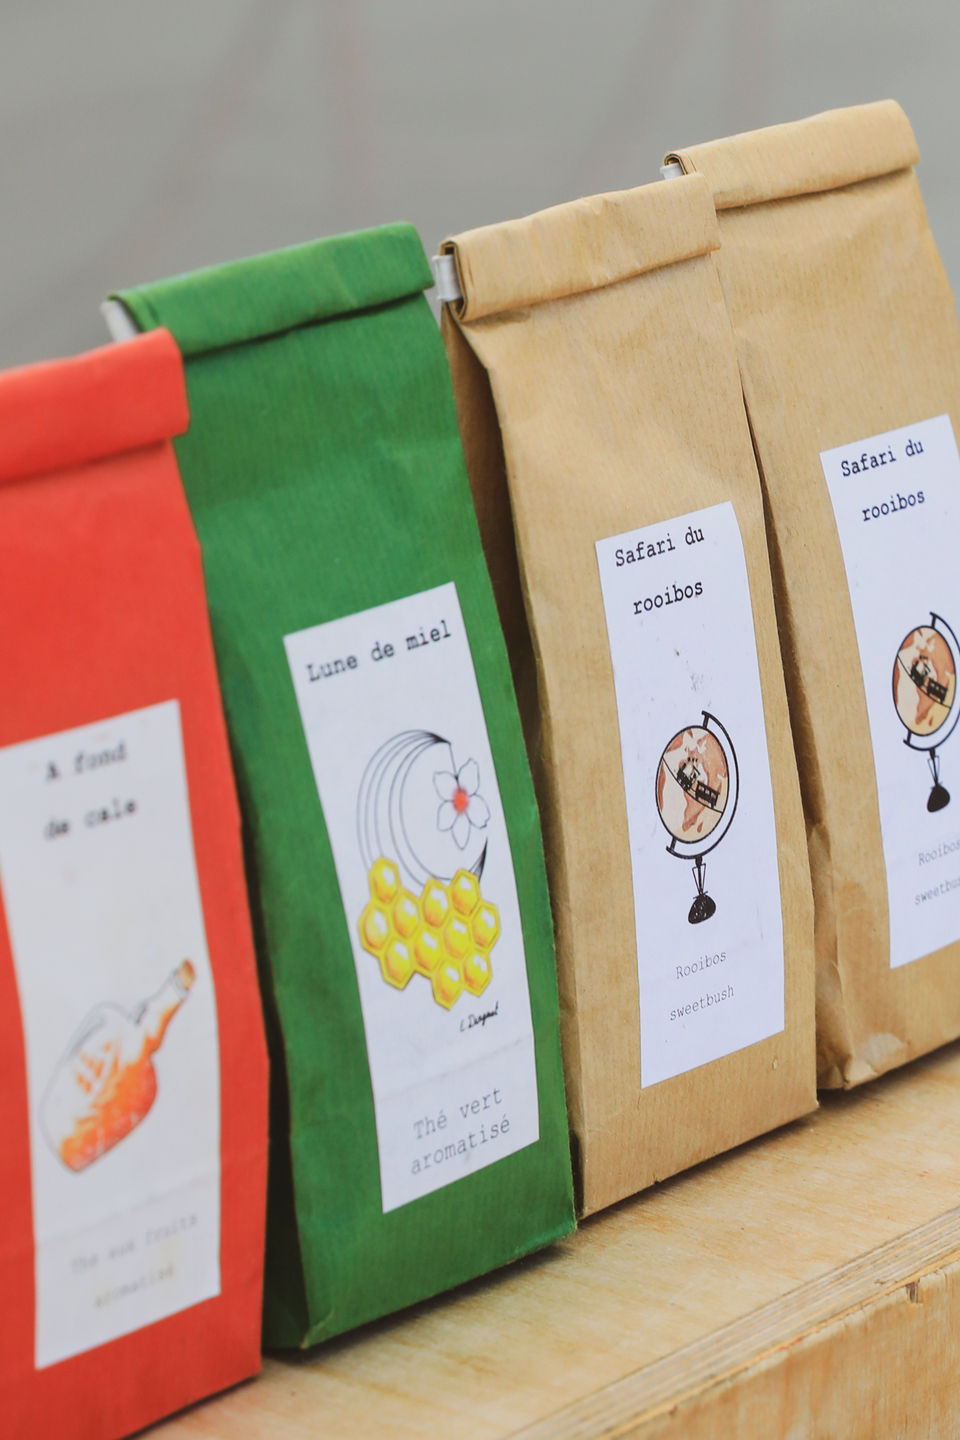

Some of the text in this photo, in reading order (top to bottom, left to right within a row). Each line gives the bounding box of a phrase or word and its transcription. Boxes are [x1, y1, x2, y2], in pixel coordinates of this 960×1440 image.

[841, 439, 924, 477] Safari du
[862, 491, 925, 522] rooibos
[615, 526, 705, 567] Safari du
[633, 581, 704, 615] rooibos
[306, 619, 452, 682] Lune de miel
[75, 741, 127, 774] fond
[44, 798, 137, 841] de cale
[675, 951, 727, 980] Rooibos
[669, 984, 735, 1021] sweetbush
[412, 1087, 502, 1140] Thé vert
[411, 1113, 510, 1176] aromatisé
